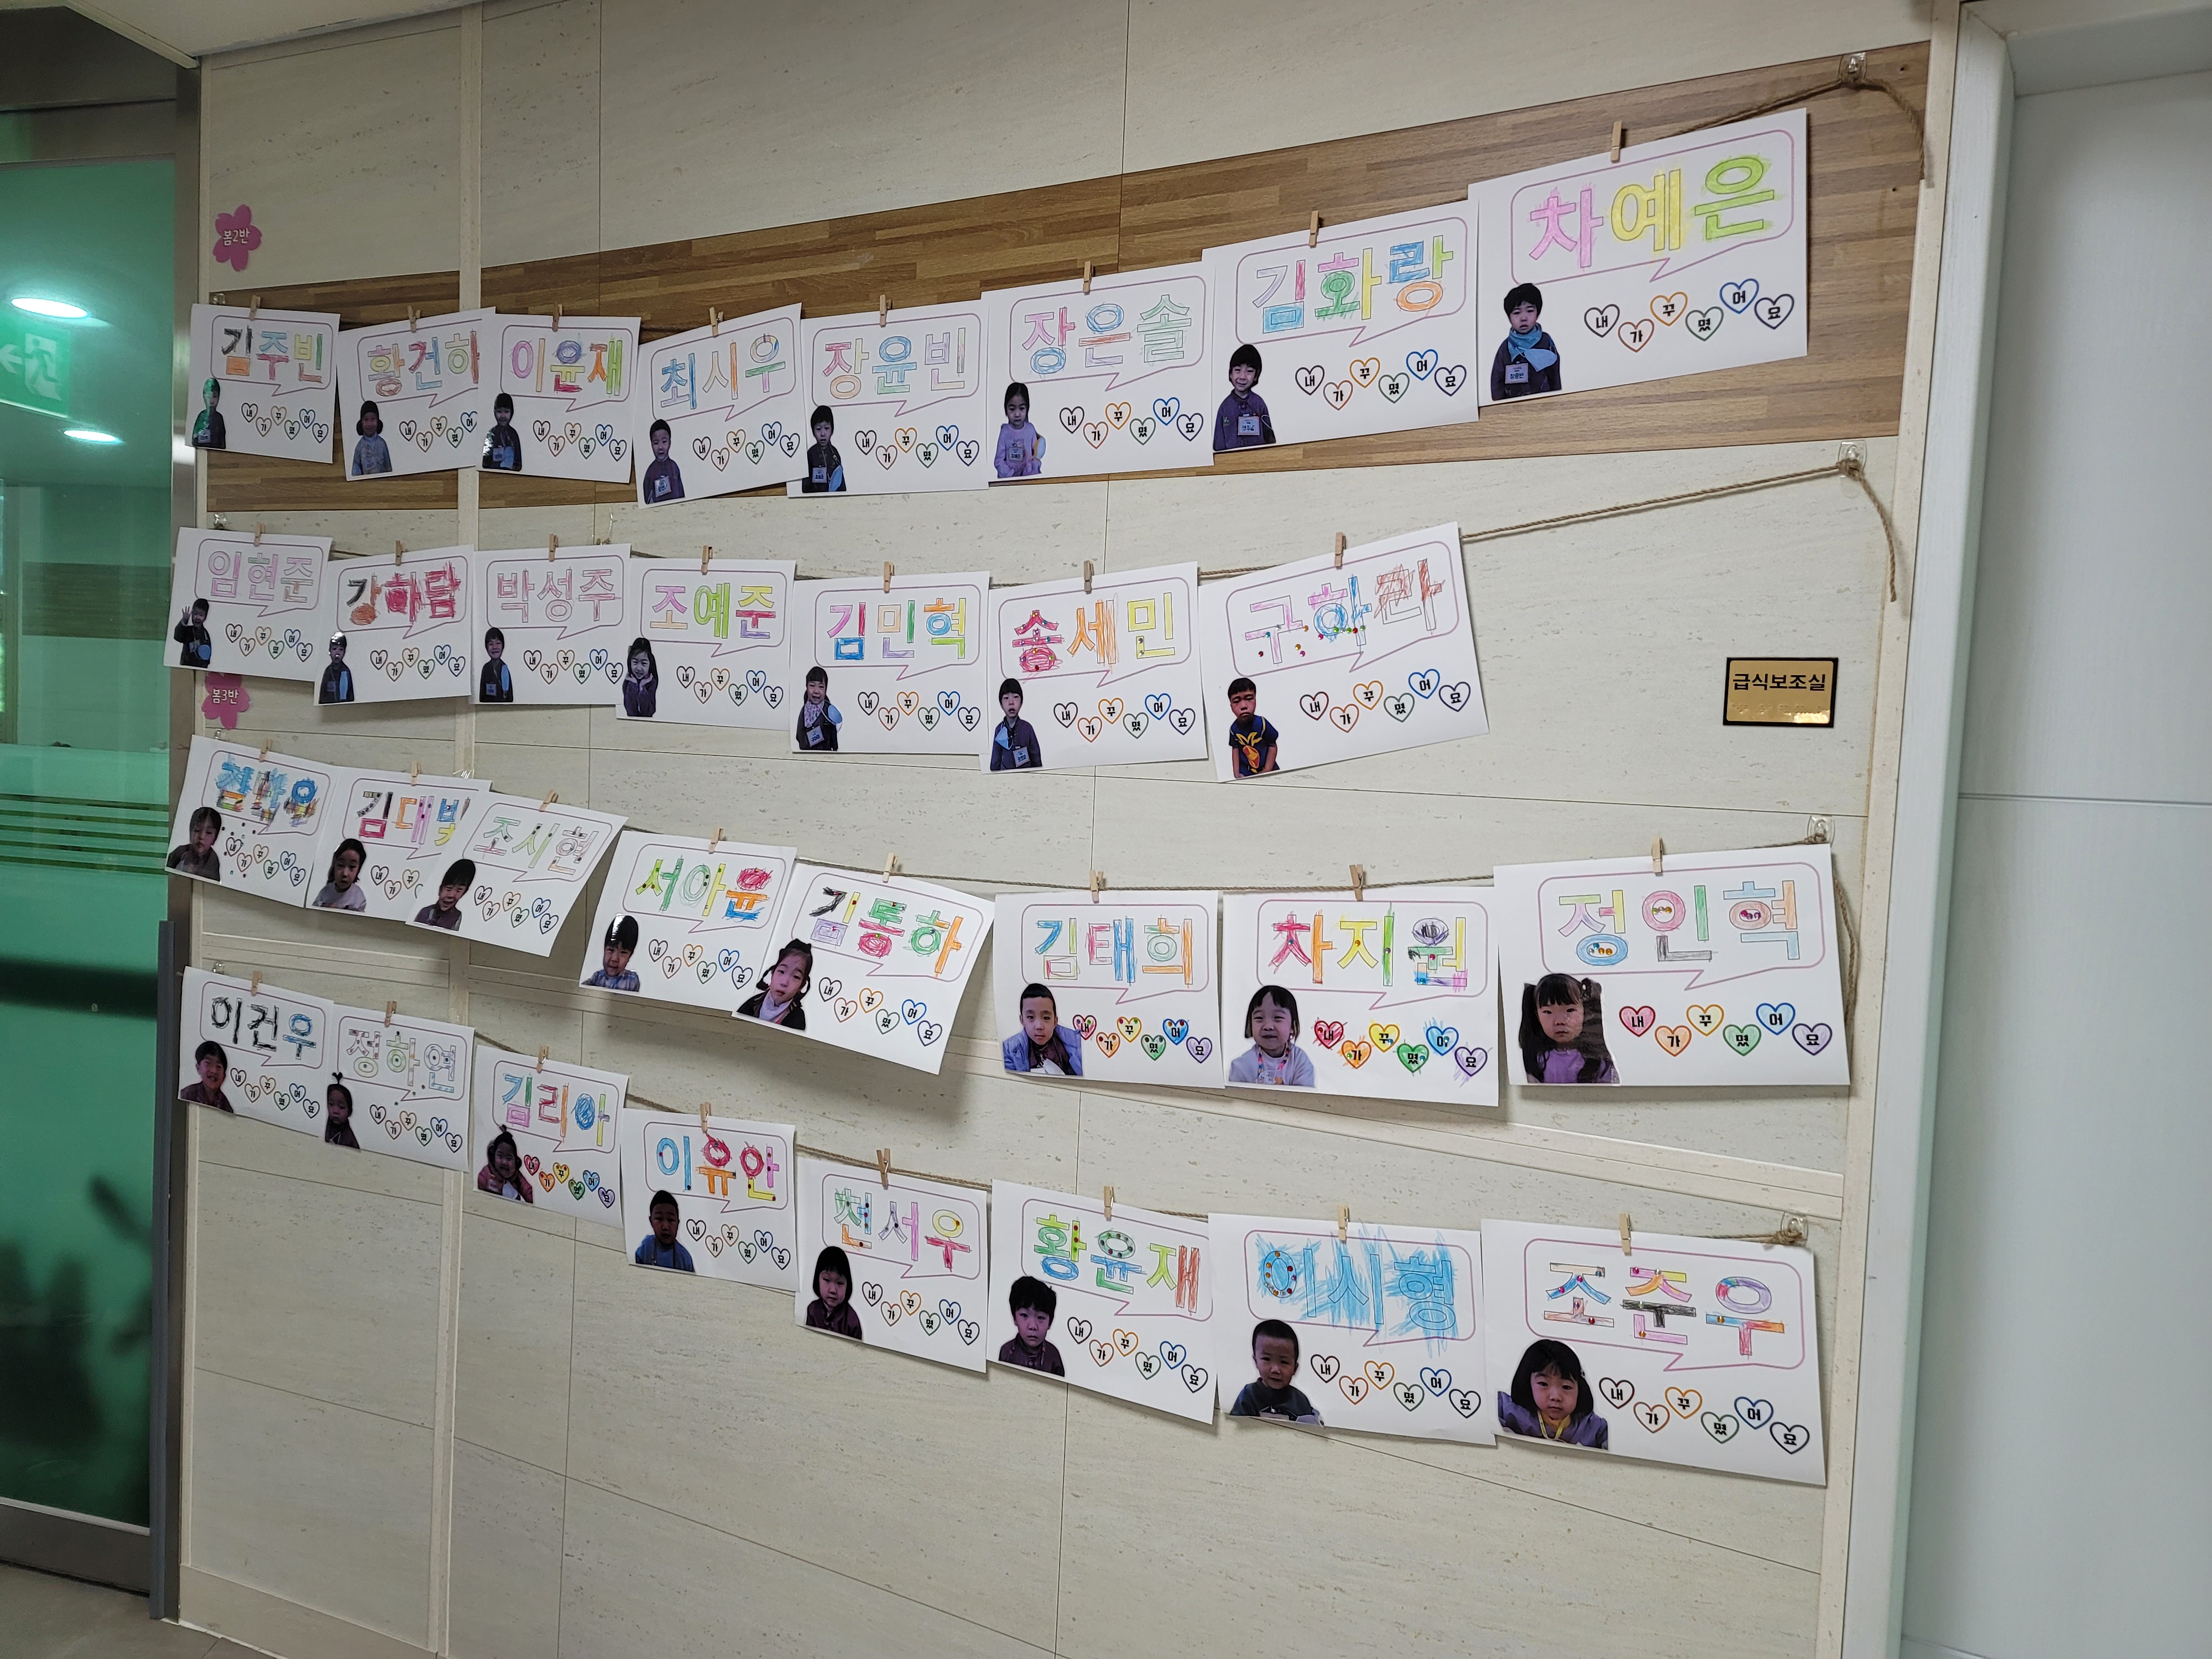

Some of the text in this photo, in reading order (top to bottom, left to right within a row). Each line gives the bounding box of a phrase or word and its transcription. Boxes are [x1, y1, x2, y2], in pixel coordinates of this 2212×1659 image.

[223, 228, 250, 246] 봄2반
[1530, 156, 1775, 268] 차예은
[1252, 235, 1454, 335] 김화랑
[222, 327, 323, 383] 김주빈
[511, 337, 623, 396] 이윤재
[823, 327, 966, 400] 장윤빈
[1022, 295, 1192, 374] 장은솔
[660, 333, 786, 410] 최시우
[208, 550, 314, 603] 임현준
[498, 567, 618, 622] 박성주
[650, 582, 775, 639] 조예준
[1245, 559, 1442, 664] 구하라
[827, 597, 967, 660] 김민혁
[1013, 592, 1175, 672] 송세민
[212, 688, 239, 705] 봄3반
[1732, 673, 1826, 691] 급식보조실
[473, 817, 599, 875] 조시현
[635, 858, 771, 920] 서아윤
[1558, 880, 1799, 966] 정인혁
[809, 887, 963, 973] 김동하
[1035, 917, 1193, 985] 김태희
[1272, 912, 1467, 987] 차지원
[211, 997, 316, 1060] 이건우
[347, 1029, 456, 1093] 정하연
[502, 1074, 610, 1146] 김리아
[656, 1135, 780, 1201] 이유안
[834, 1187, 971, 1269] 천서우
[1034, 1214, 1200, 1313] 황윤재
[1261, 1248, 1456, 1331] 이시형
[1544, 1262, 1785, 1356] 조준우
